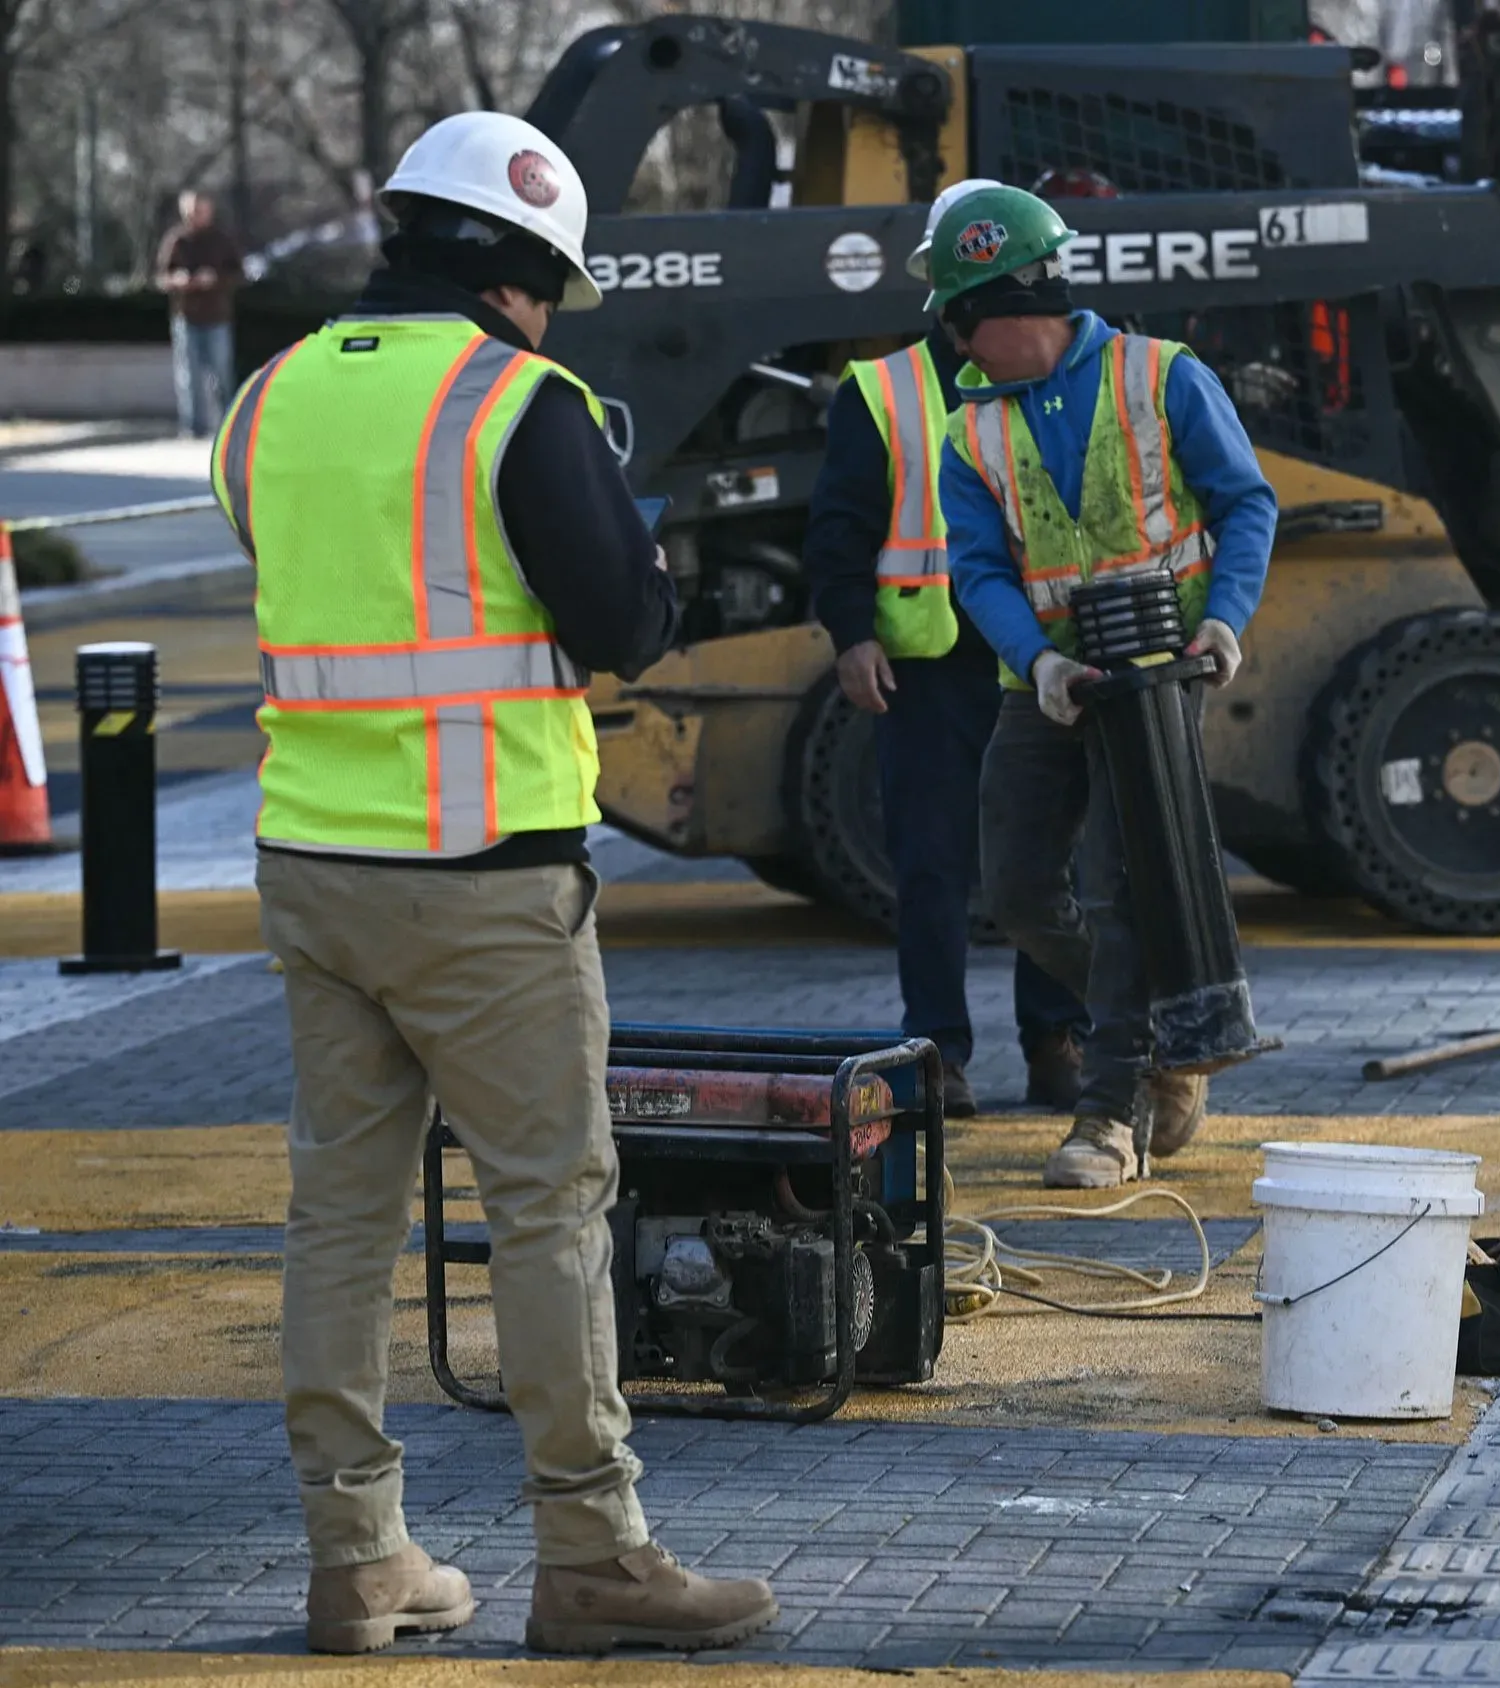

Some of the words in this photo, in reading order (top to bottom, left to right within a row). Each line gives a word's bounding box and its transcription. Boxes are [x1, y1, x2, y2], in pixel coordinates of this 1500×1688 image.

[1264, 210, 1307, 245] 61
[587, 251, 723, 291] 328E
[1057, 229, 1260, 285] EERE
